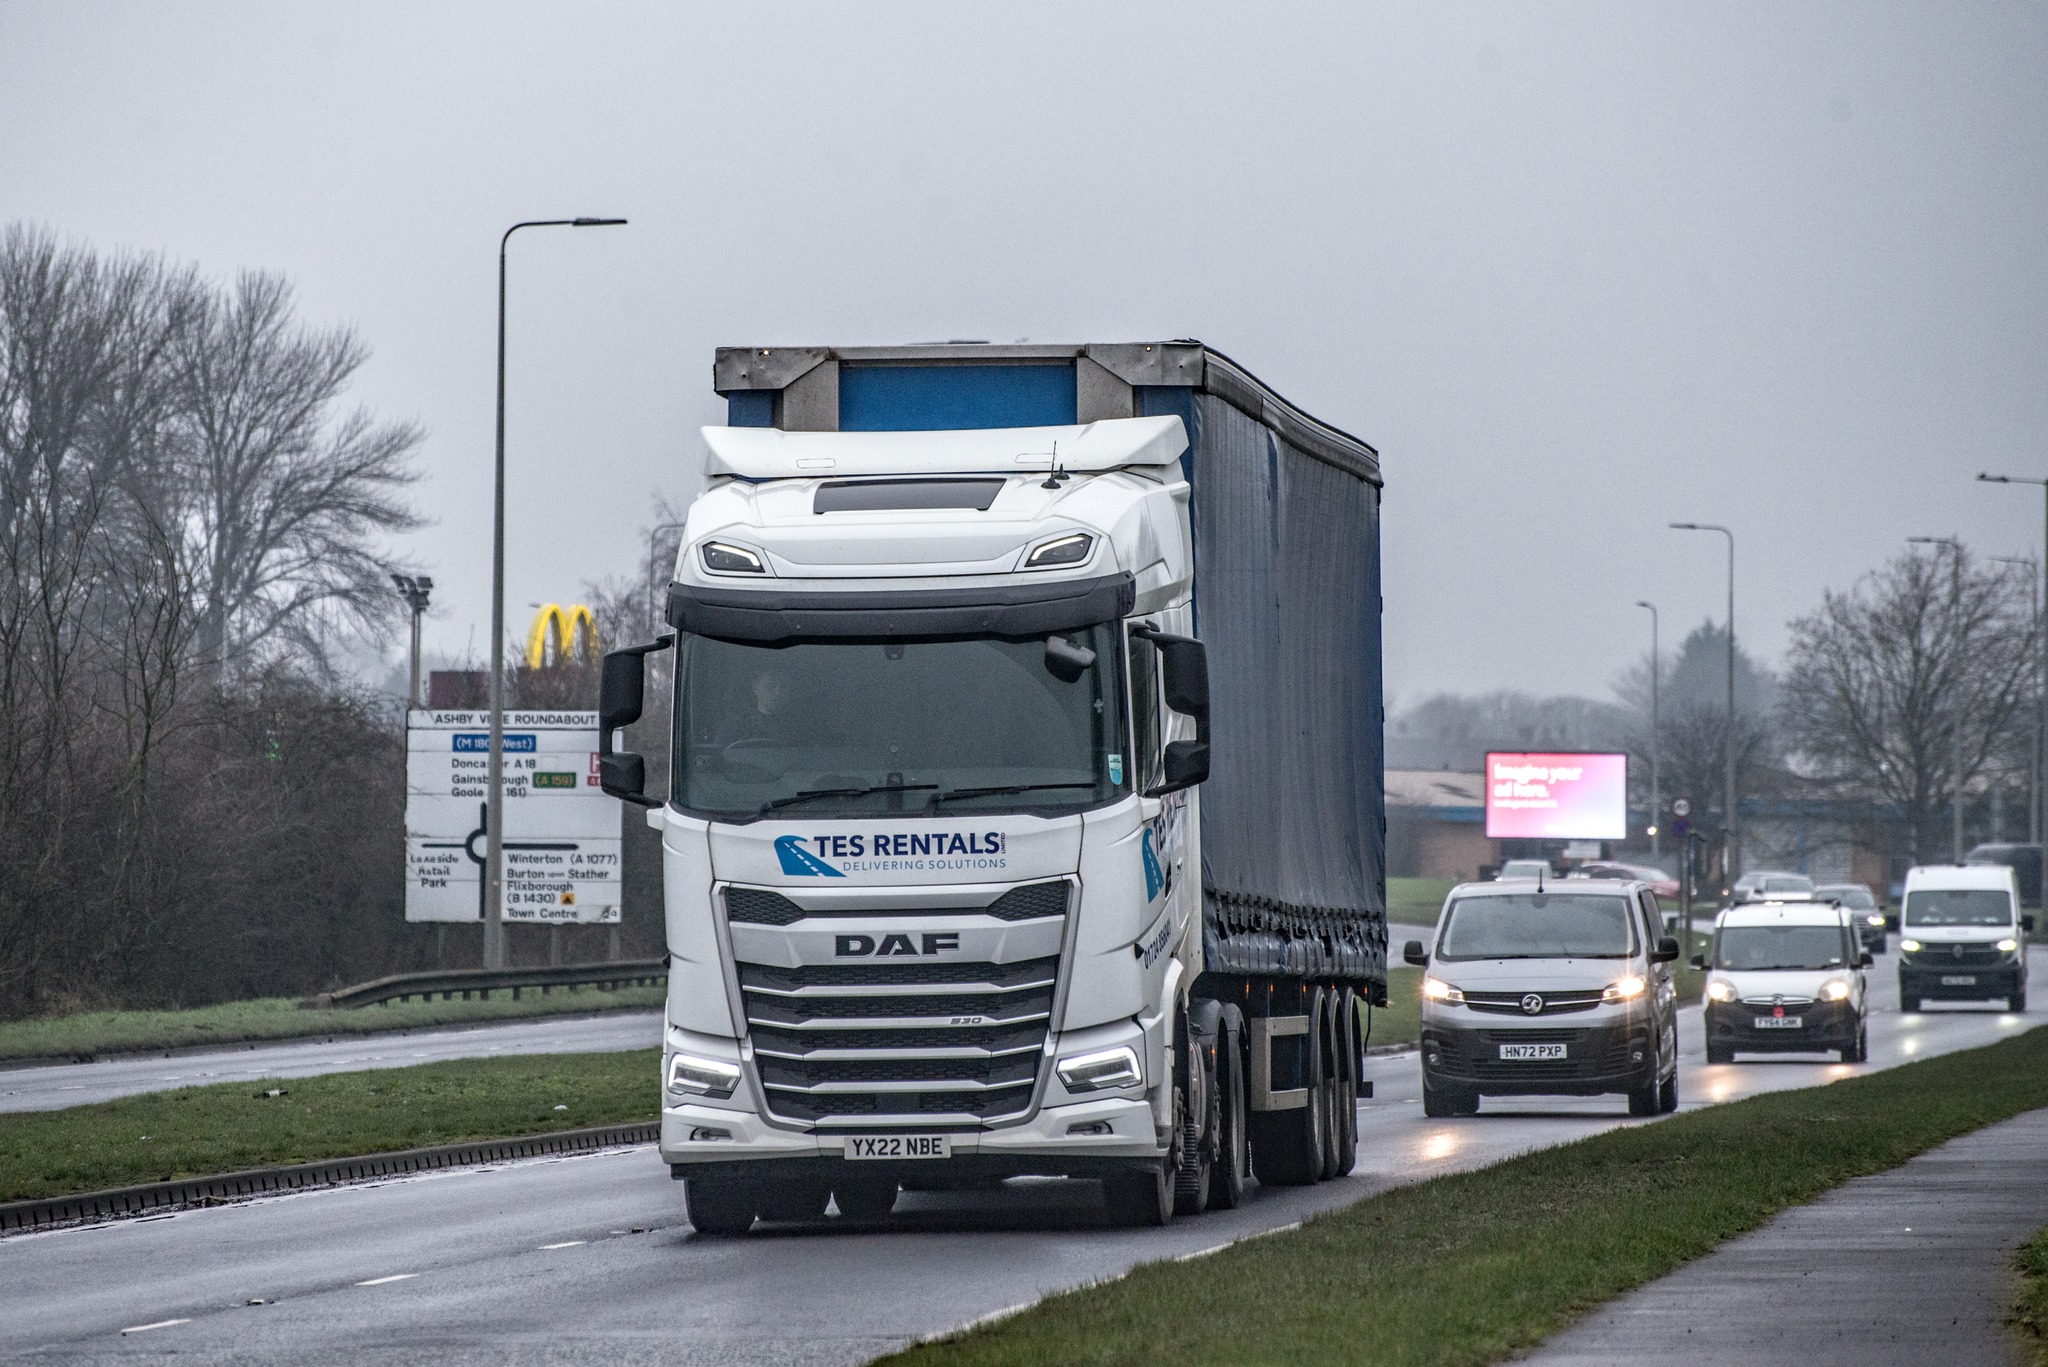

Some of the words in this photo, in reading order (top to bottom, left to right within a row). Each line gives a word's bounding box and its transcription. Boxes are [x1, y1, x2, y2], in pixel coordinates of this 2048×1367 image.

[435, 714, 474, 725] ASHBY
[479, 714, 510, 725] VIE
[515, 715, 596, 725] ROUNDABOUT
[452, 759, 509, 769] Doncar
[452, 775, 528, 786] Gainsbough
[452, 787, 484, 797] Goole
[814, 835, 864, 857] TES
[874, 831, 1000, 856] RENTALS
[508, 854, 562, 864] Winterton
[843, 860, 924, 871] DELIVERING
[928, 858, 1006, 869] SOLUTIONS
[507, 868, 545, 879] Burton
[568, 868, 609, 879] Stather
[421, 878, 447, 888] Park
[507, 881, 573, 893] Flixborough
[507, 908, 534, 918] Town
[540, 908, 578, 919] Centre
[835, 932, 959, 957] DAF
[1505, 1046, 1536, 1057] HN72
[1539, 1046, 1562, 1056] PXP
[853, 1139, 901, 1156] YX22
[906, 1138, 943, 1155] NBE
